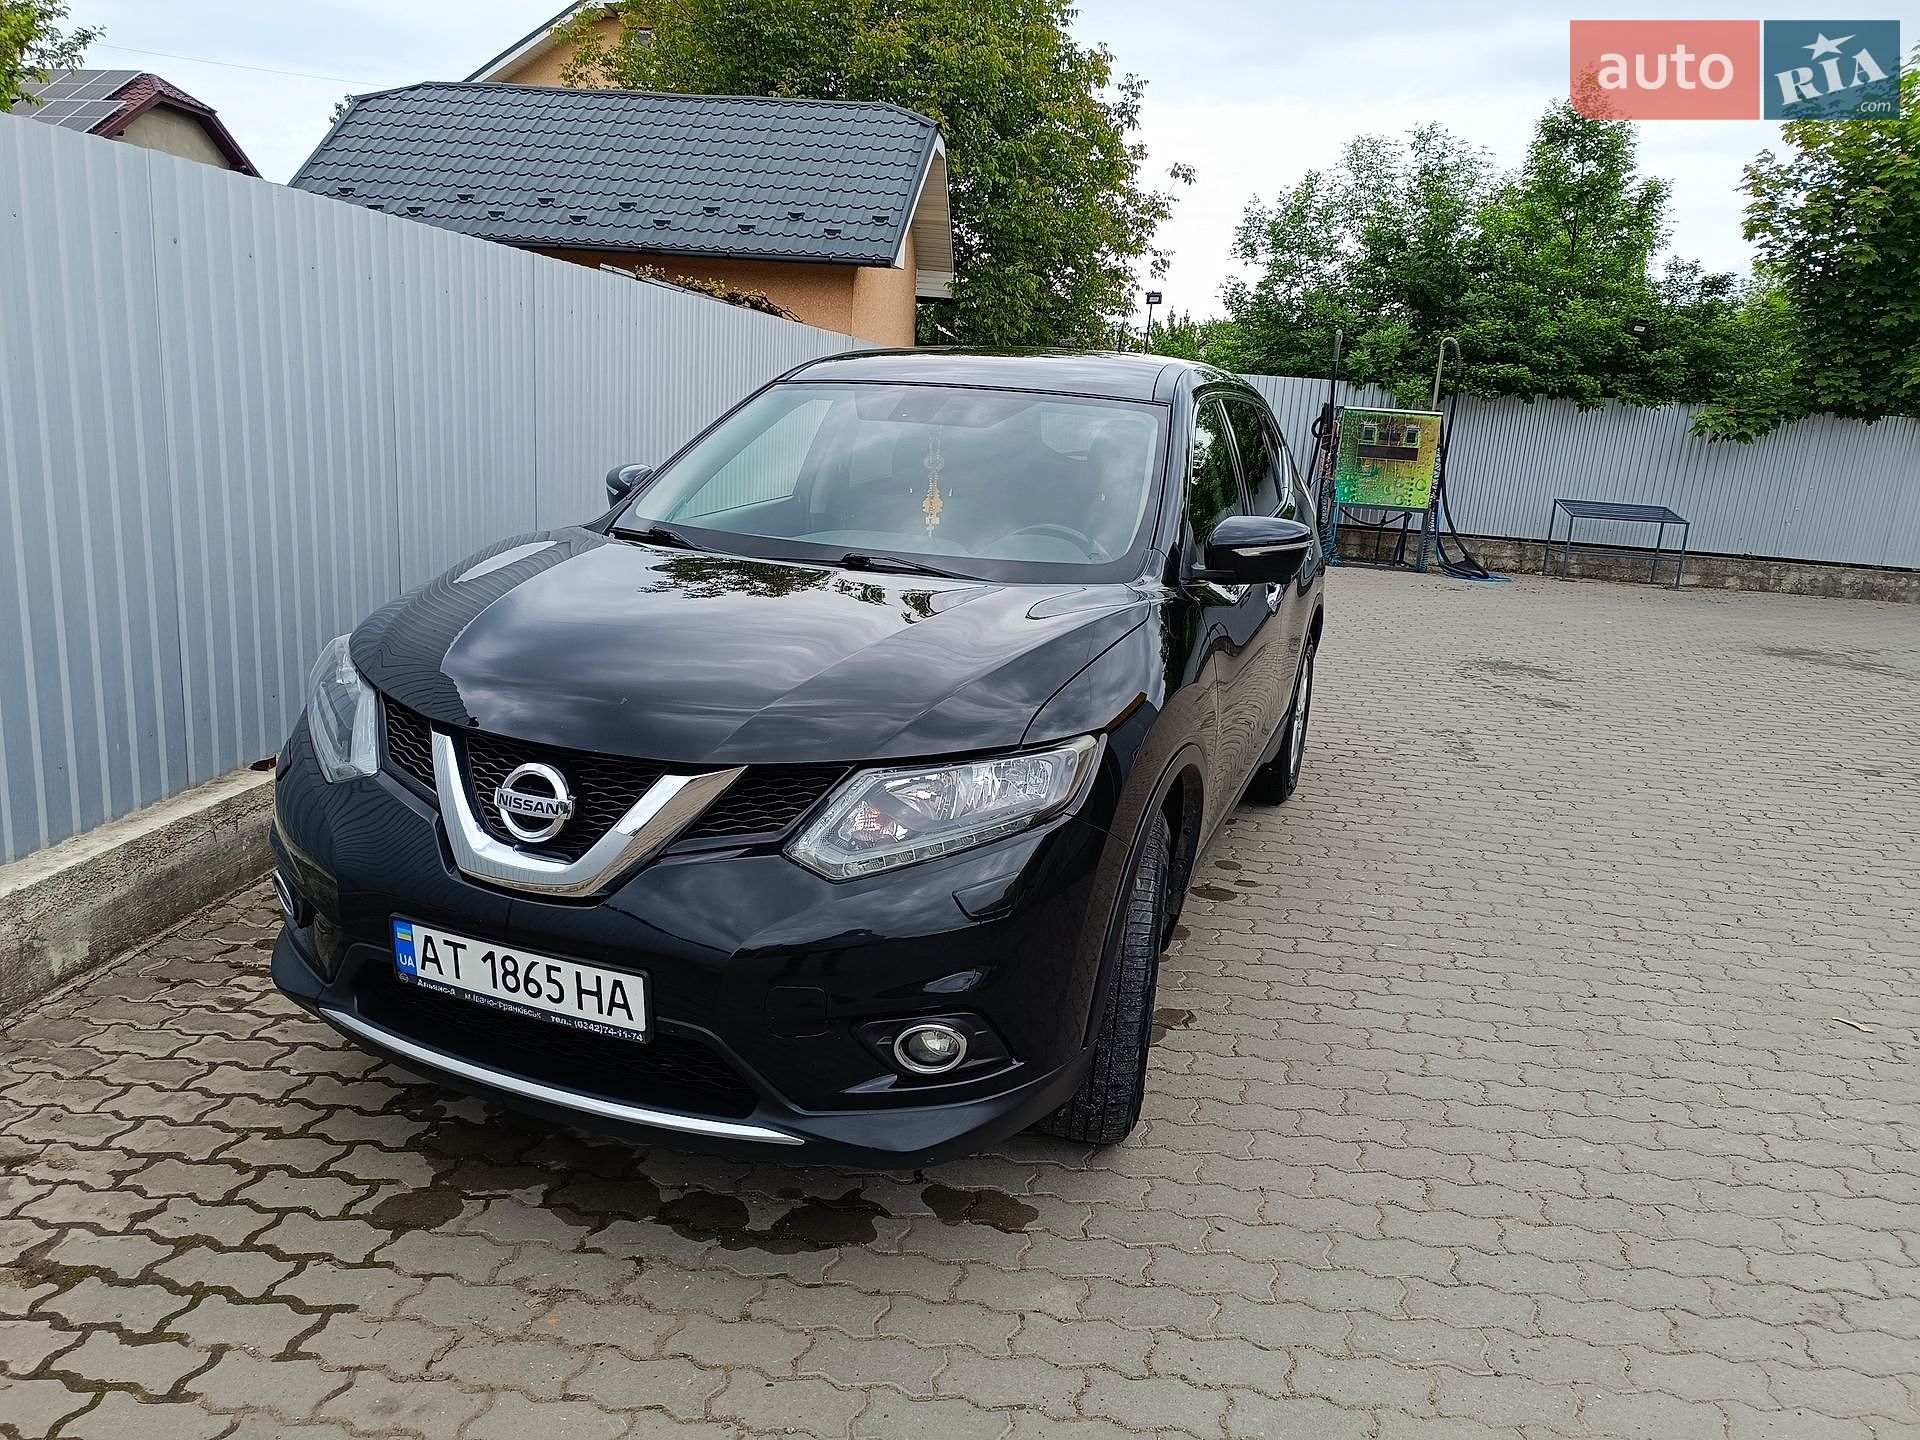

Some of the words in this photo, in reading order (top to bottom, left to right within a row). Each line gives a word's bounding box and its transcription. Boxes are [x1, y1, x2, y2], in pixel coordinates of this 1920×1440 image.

[498, 793, 560, 815] NISSAN
[399, 953, 415, 968] UA
[420, 934, 467, 980] AT
[480, 950, 566, 1004] 1865
[575, 970, 635, 1022] HA
